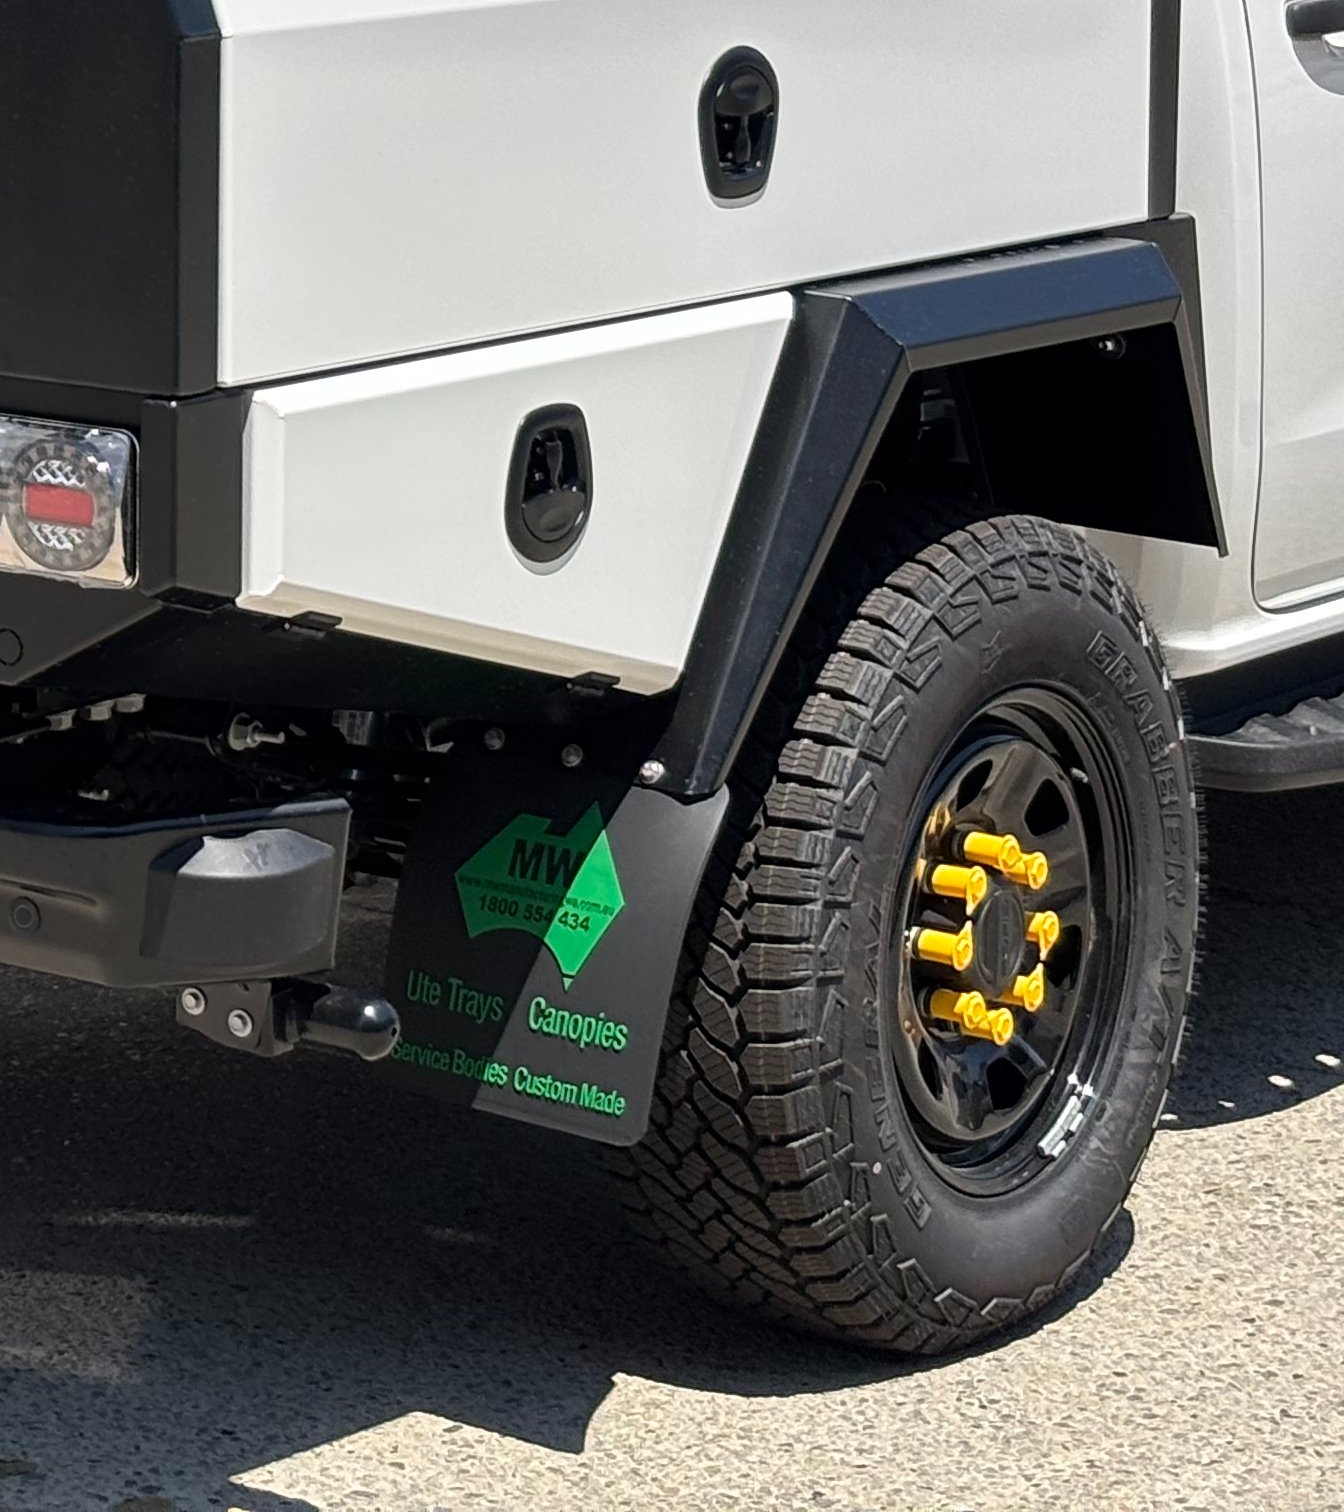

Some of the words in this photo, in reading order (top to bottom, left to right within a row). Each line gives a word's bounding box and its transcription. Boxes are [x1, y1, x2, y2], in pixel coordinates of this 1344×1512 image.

[1086, 628, 1188, 909] GRABBER
[507, 837, 588, 889] MW
[479, 893, 520, 918] 1800
[522, 903, 553, 924] 554
[557, 911, 591, 933] 434
[405, 969, 442, 1007] Ute
[447, 977, 505, 1026] Trays
[527, 996, 629, 1052] Canopies
[390, 1034, 451, 1072] Service
[452, 1049, 509, 1087] Bodies
[863, 899, 933, 1230] GENERAL
[514, 1065, 578, 1105] Custom
[579, 1081, 627, 1118] Made
